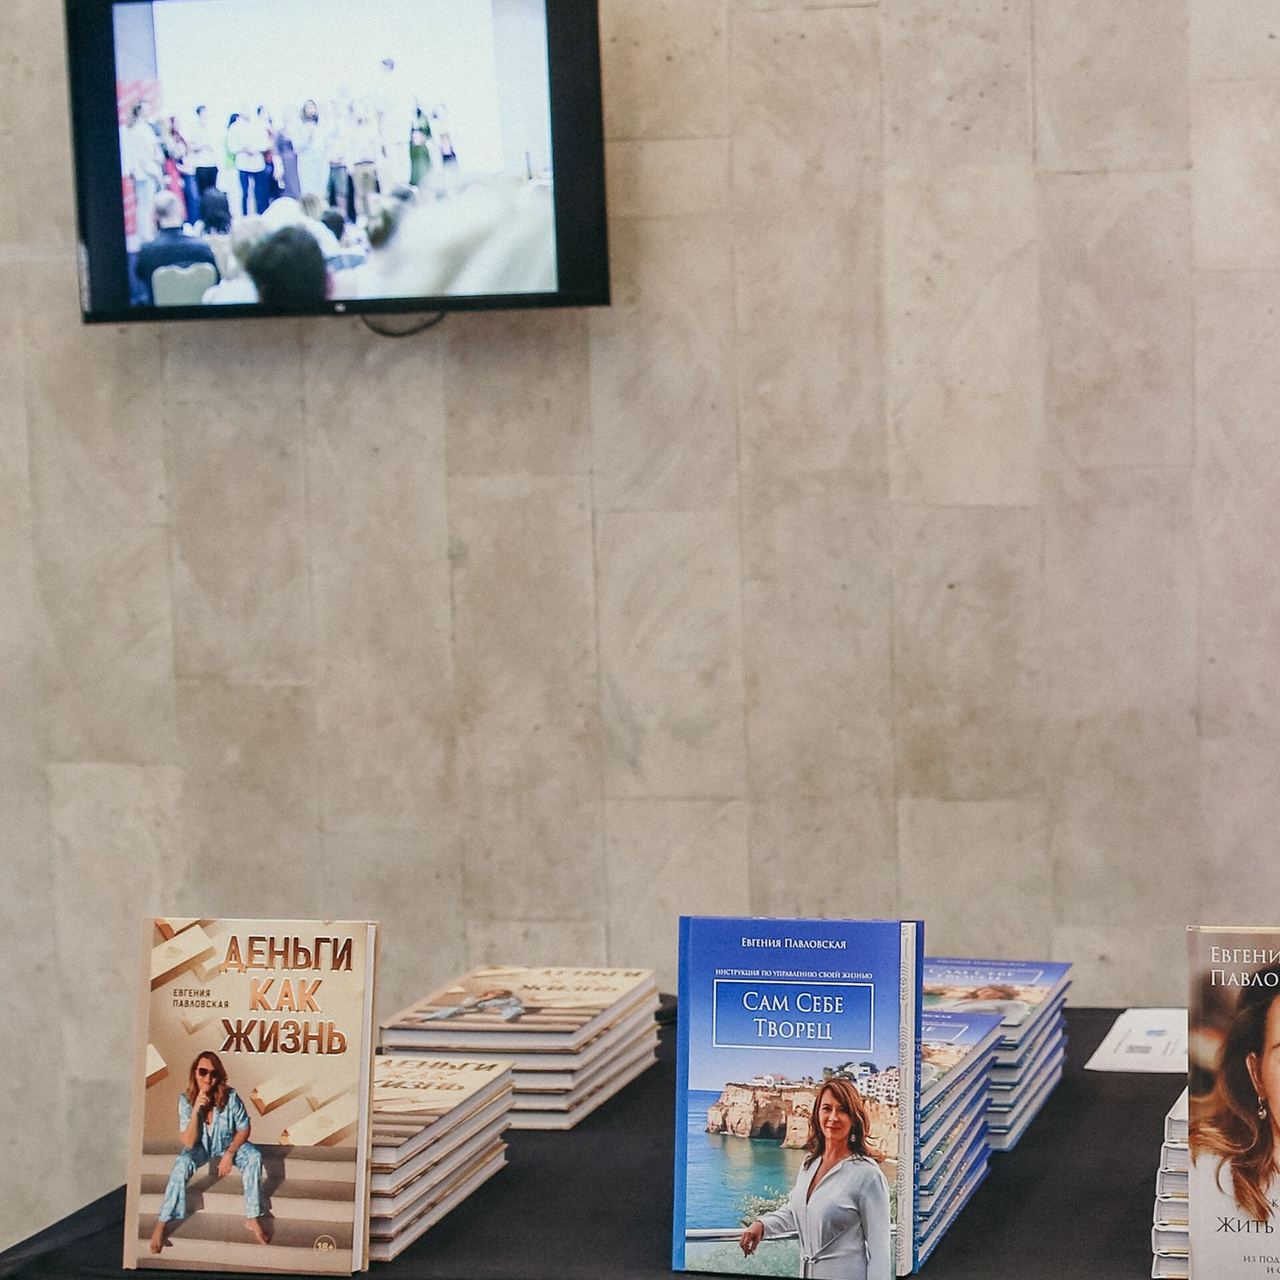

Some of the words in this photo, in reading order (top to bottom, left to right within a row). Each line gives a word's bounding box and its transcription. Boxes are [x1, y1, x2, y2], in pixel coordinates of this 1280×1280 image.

[219, 935, 353, 973] ДЕНЬГИ
[715, 969, 760, 977] ИНСТРУКЦИЯ
[773, 970, 818, 978] УПРАВЛЕНИЮ
[818, 970, 841, 978] СВОЕЙ
[173, 988, 211, 998] ЕВГЕНИЯ
[250, 978, 323, 1013] КАК
[743, 991, 790, 1012] САМ
[796, 992, 844, 1013] СЕБЕ
[172, 999, 230, 1009] ПАВЛОВСКАЯ
[219, 1018, 348, 1054] ЖИЗНЬ
[753, 1018, 833, 1040] ТВОРЕЦ
[1216, 1216, 1274, 1234] ЖИТЬ
[1243, 1255, 1256, 1263] ИЗ
[1259, 1255, 1280, 1264] ПОД
[1266, 1266, 1274, 1274] И
